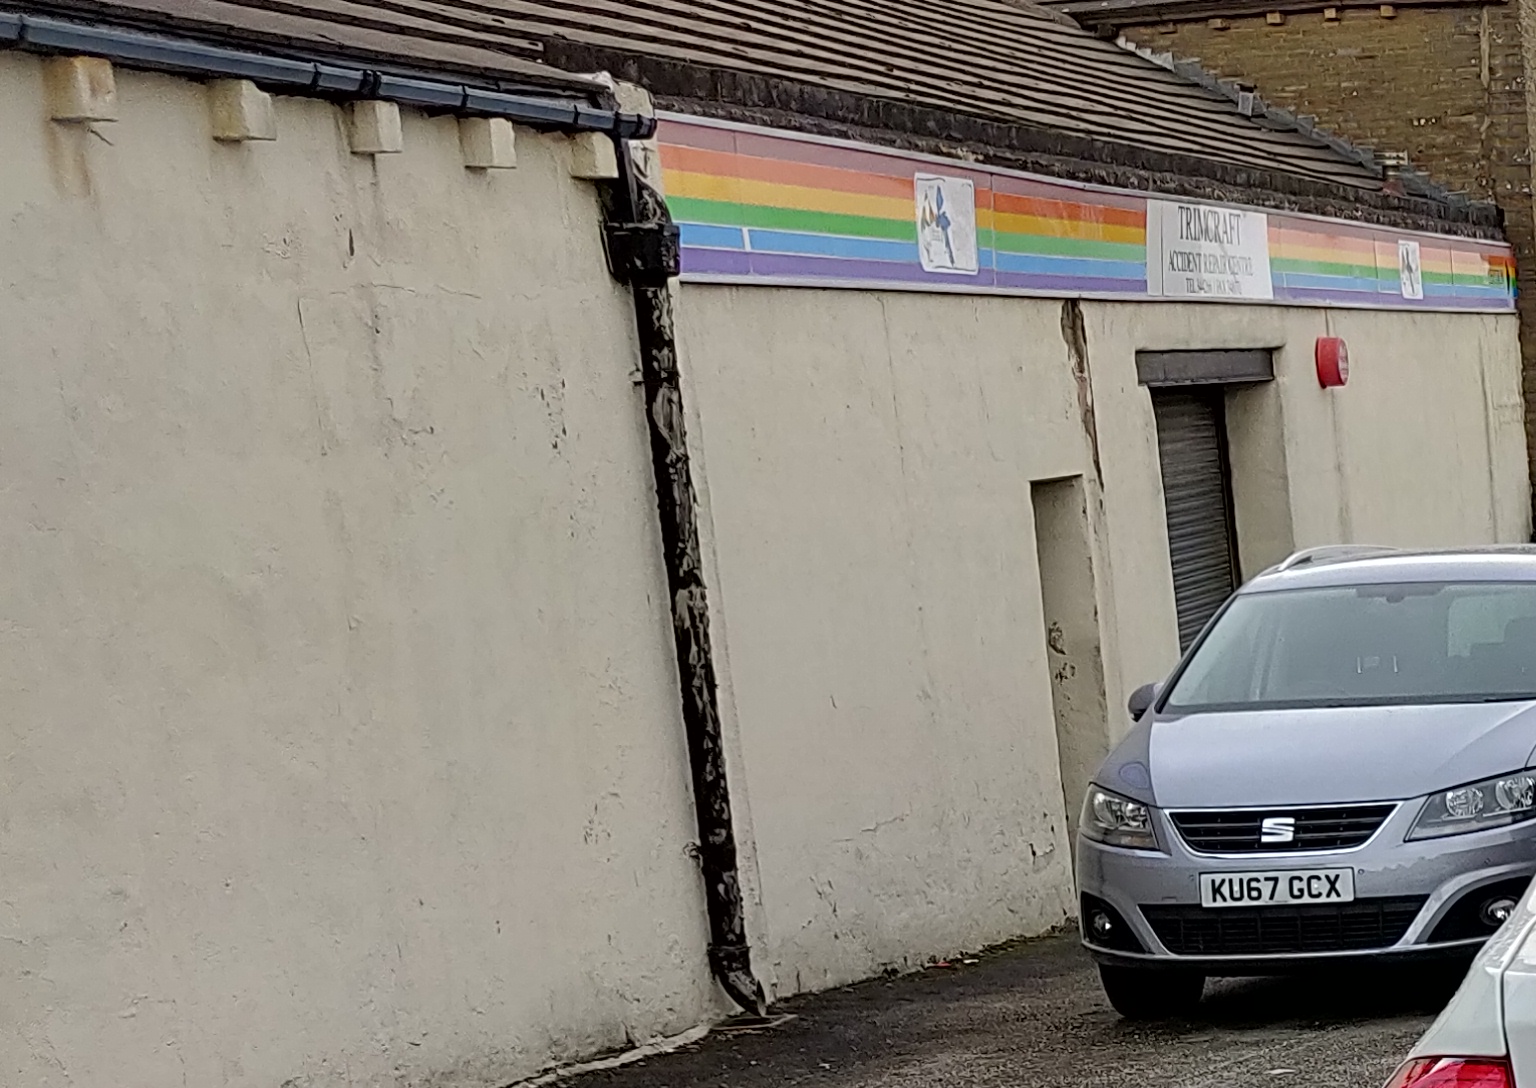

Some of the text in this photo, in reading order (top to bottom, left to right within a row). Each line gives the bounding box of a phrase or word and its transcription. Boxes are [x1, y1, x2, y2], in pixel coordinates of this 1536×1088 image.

[1178, 205, 1241, 246] TRIMCRAFT
[1168, 249, 1202, 273] ACCIDENT
[1210, 873, 1342, 903] KU67 GCX
